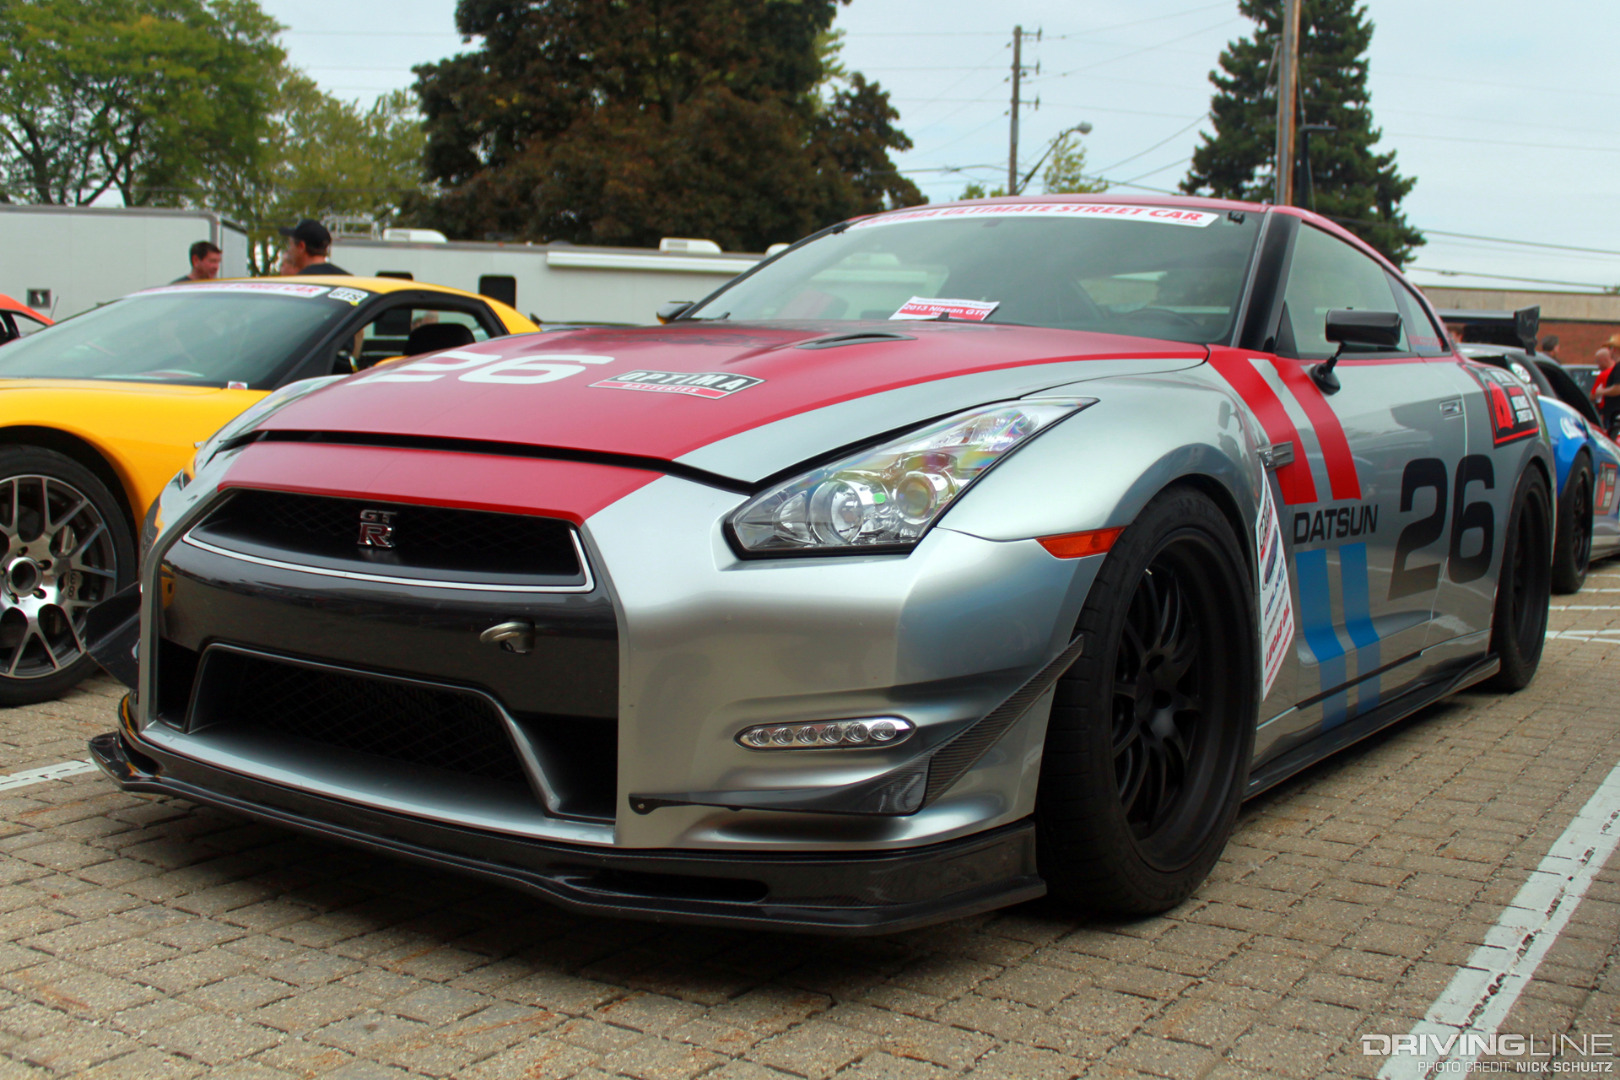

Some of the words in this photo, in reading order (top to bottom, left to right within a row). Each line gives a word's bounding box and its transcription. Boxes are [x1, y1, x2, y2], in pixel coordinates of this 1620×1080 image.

[1055, 205, 1147, 216] STREET
[1148, 209, 1204, 221] CAR
[903, 304, 928, 312] 2013
[928, 305, 963, 314] Nissan
[965, 308, 990, 316] GTR
[344, 350, 615, 385] 26
[616, 372, 748, 391] OPTIMA
[622, 383, 700, 393] BATTERIES
[360, 509, 397, 523] GT
[1293, 504, 1378, 544] DATSUN
[357, 522, 393, 548] R
[1387, 454, 1495, 601] 26
